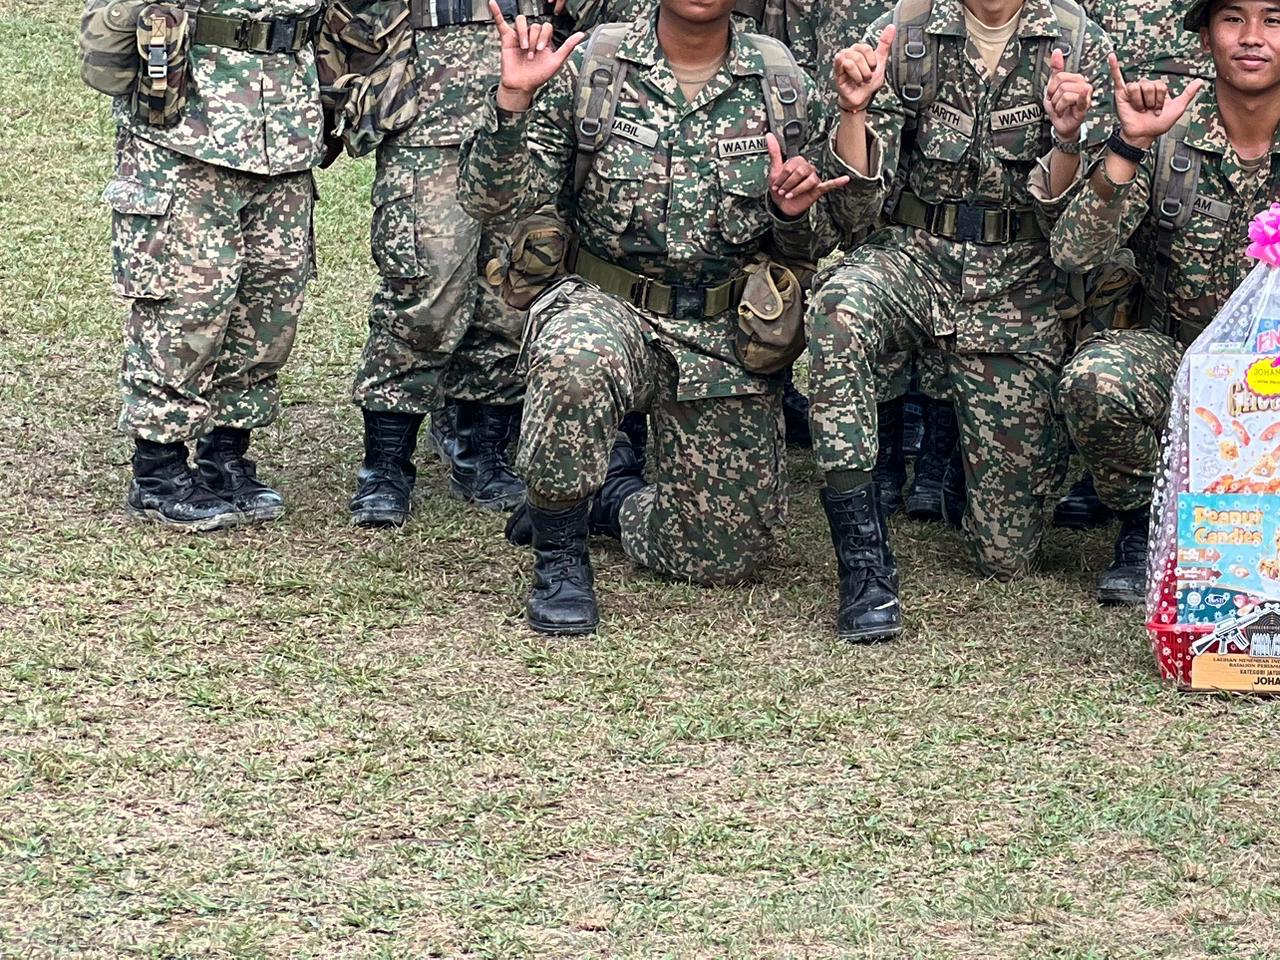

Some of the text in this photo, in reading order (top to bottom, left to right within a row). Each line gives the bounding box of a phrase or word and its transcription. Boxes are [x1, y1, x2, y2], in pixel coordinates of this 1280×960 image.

[928, 103, 960, 126] HARITH
[723, 139, 767, 153] WATANI
[1253, 368, 1280, 376] JOHAN
[1194, 505, 1264, 525] Peanut
[1194, 527, 1263, 545] Candies
